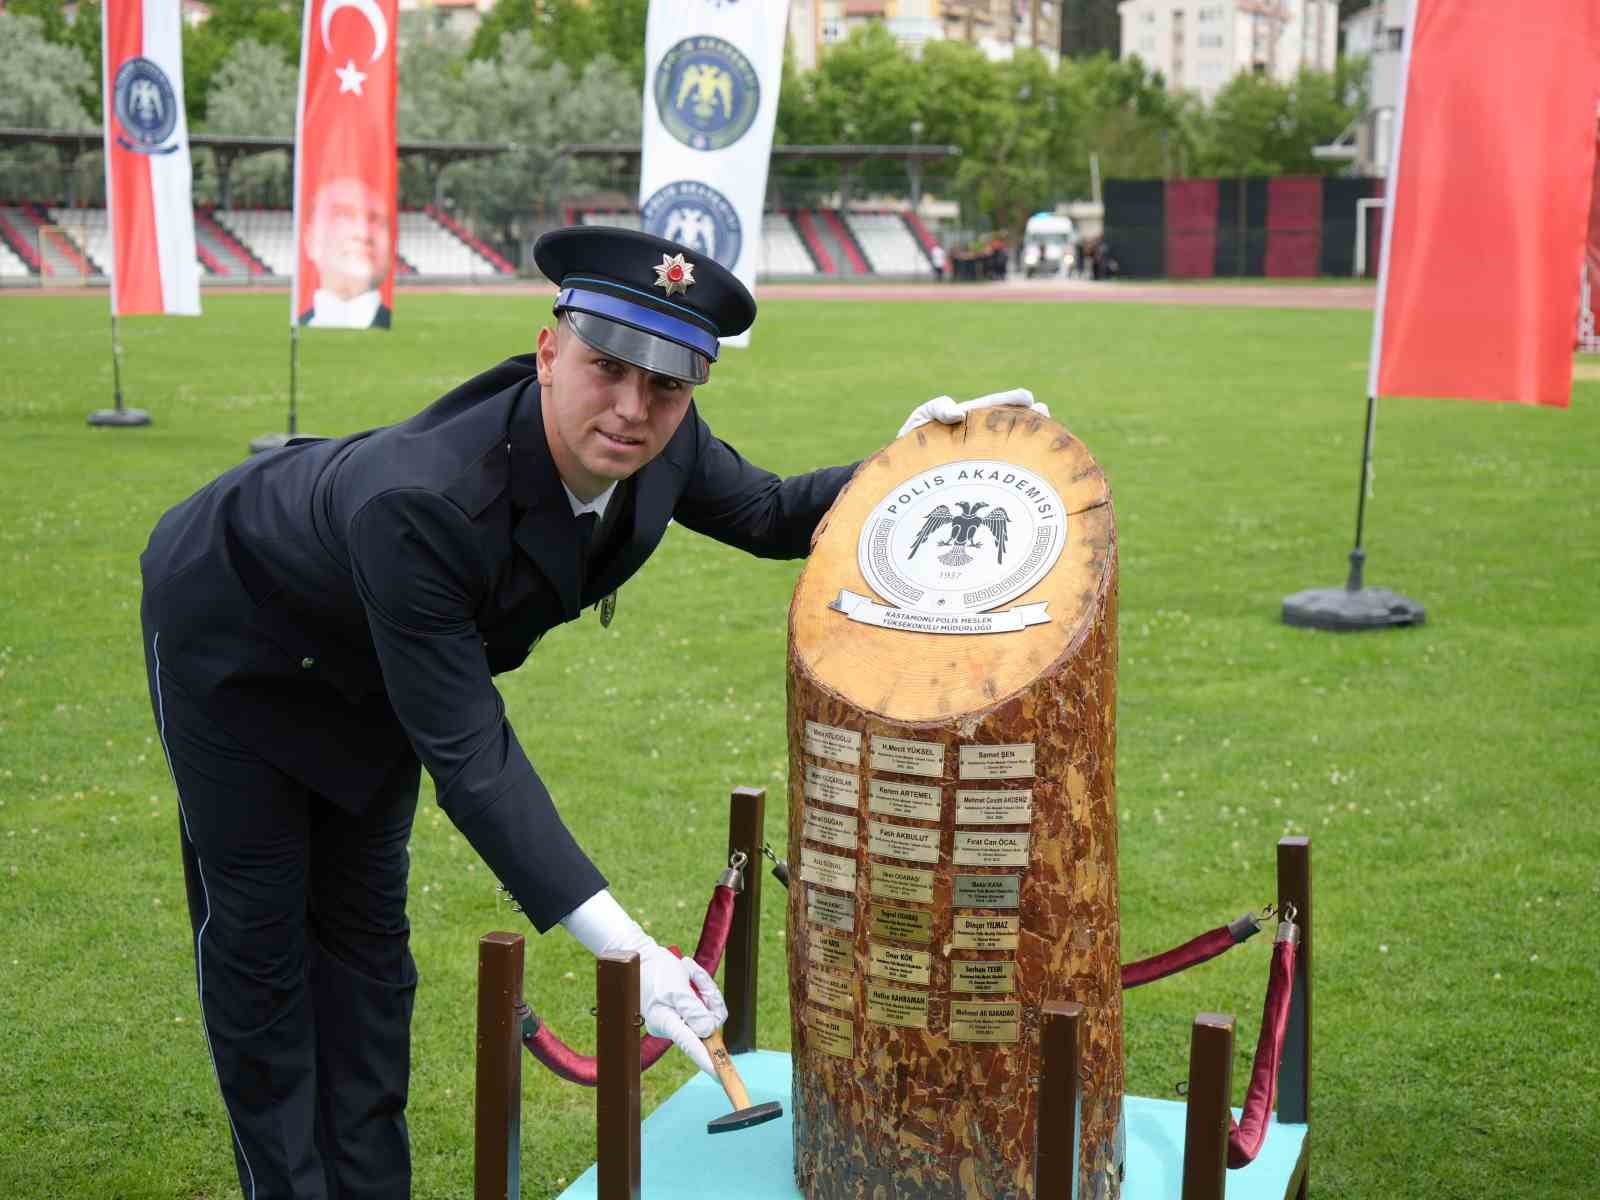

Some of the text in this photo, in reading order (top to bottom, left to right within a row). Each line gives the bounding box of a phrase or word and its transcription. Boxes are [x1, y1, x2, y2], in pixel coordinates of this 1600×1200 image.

[887, 468, 1054, 520] POLİS AKADEMİSİ
[885, 611, 935, 623] KASTAMONU
[960, 616, 993, 624] MESLEK
